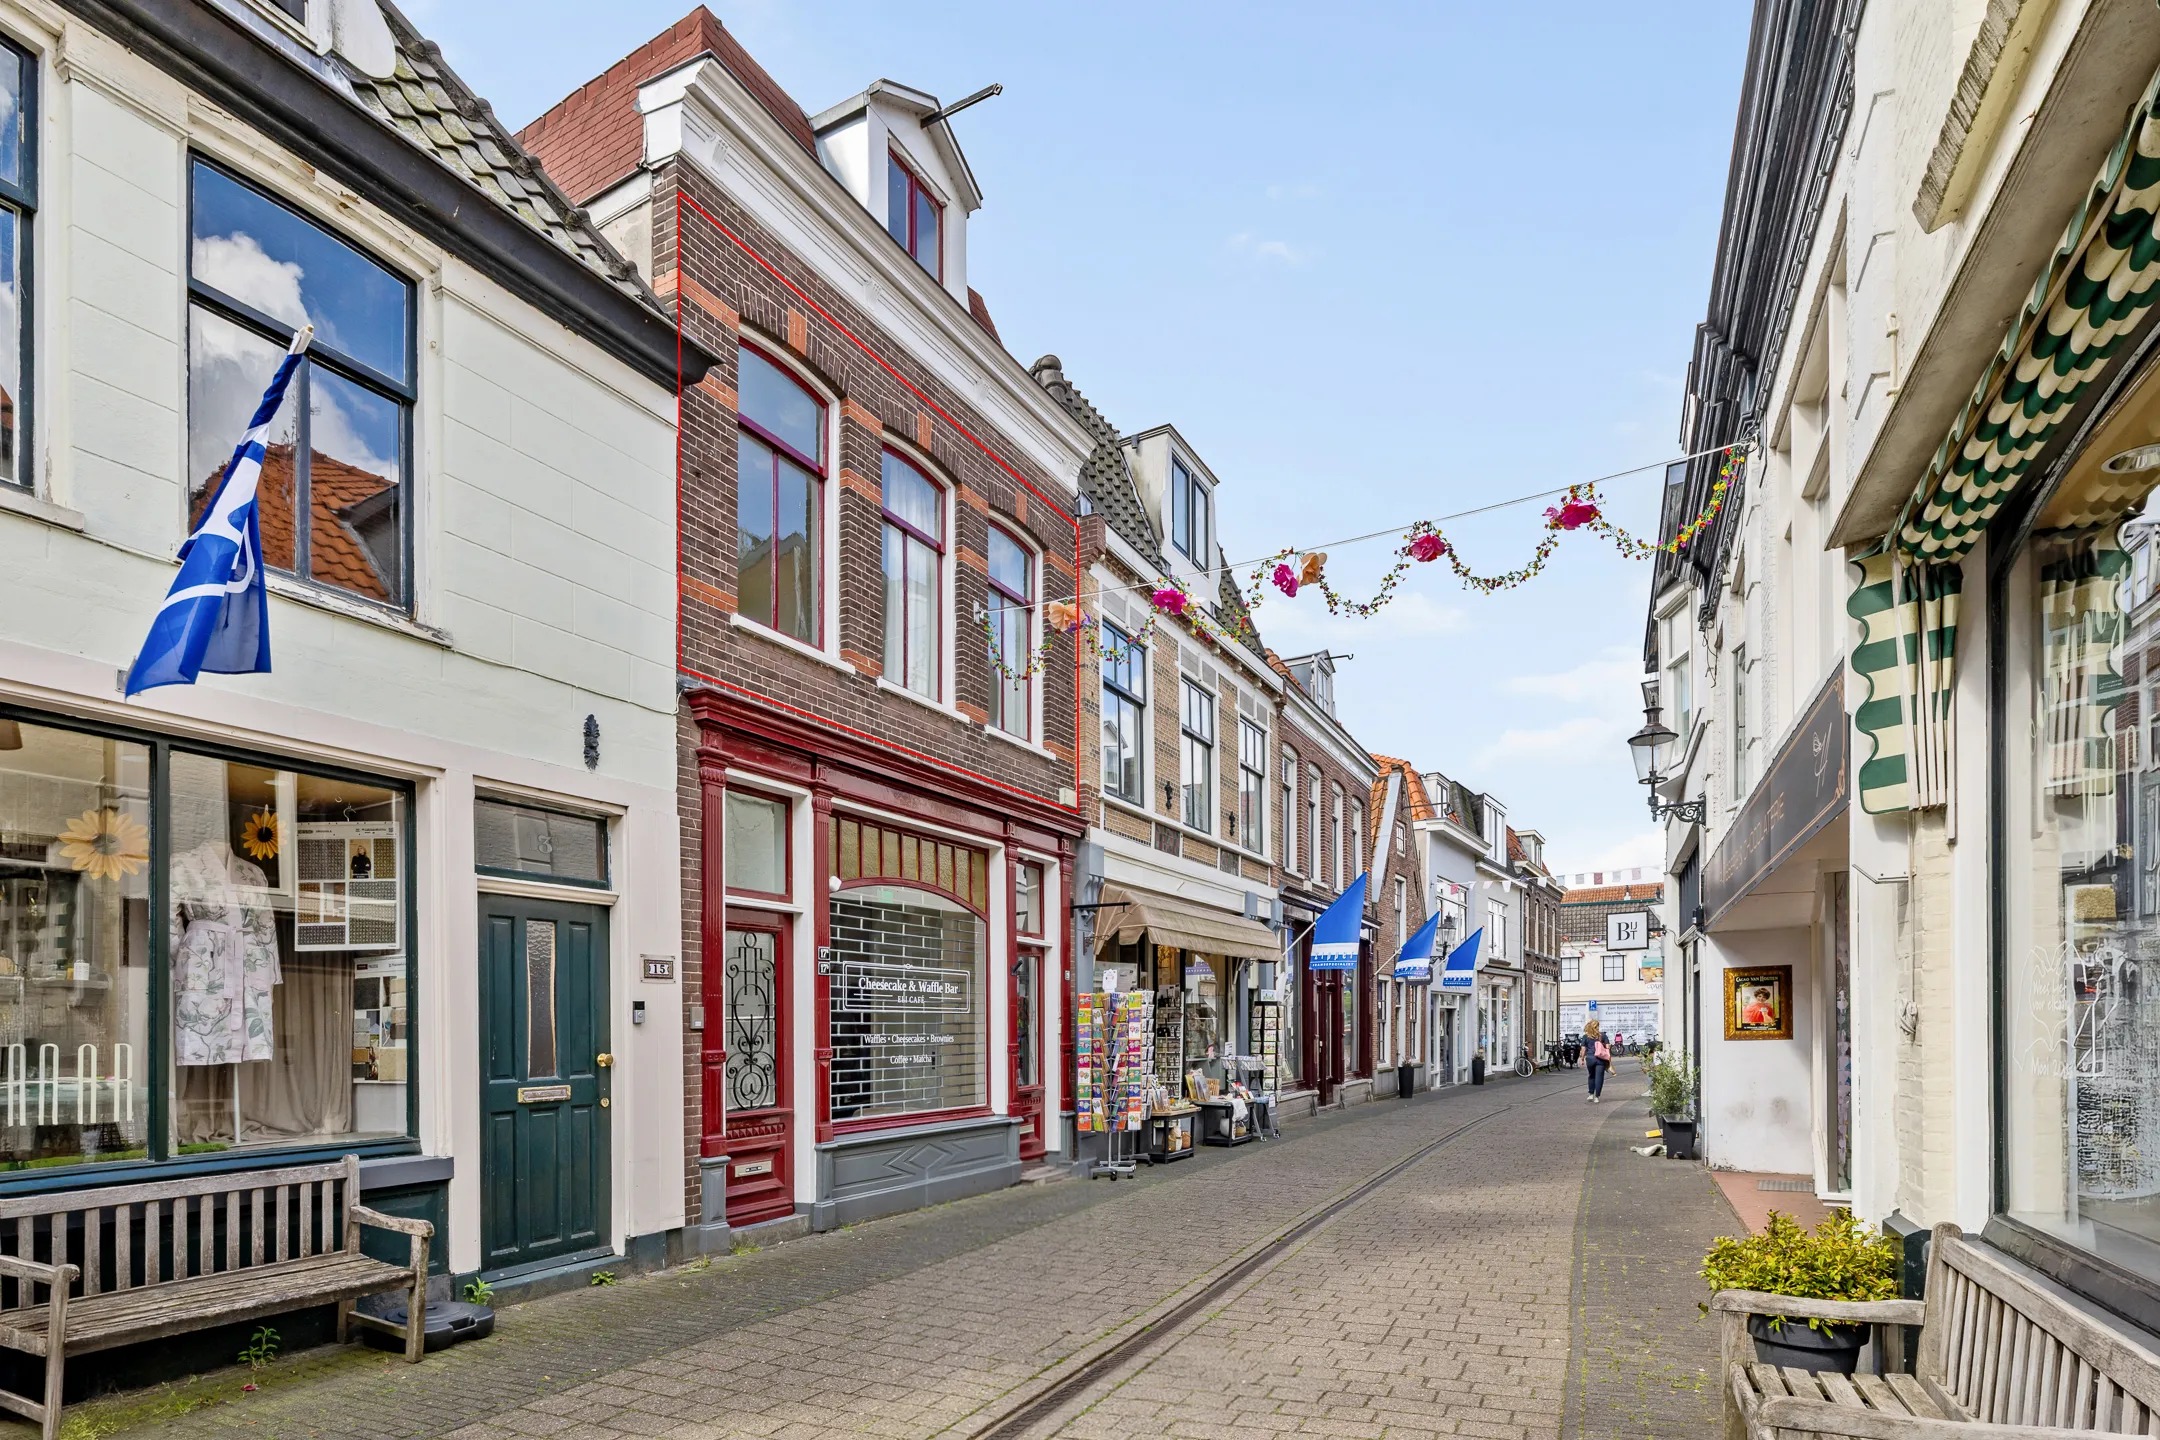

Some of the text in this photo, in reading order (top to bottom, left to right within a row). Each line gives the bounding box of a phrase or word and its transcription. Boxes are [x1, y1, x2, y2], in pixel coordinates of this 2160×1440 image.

[653, 964, 666, 974] 15
[858, 977, 959, 994] Cheesecake & Waffle Bar
[863, 1033, 955, 1044] Waffles Cheesecakes Brownies
[889, 1054, 932, 1065] Coffee Matcha
